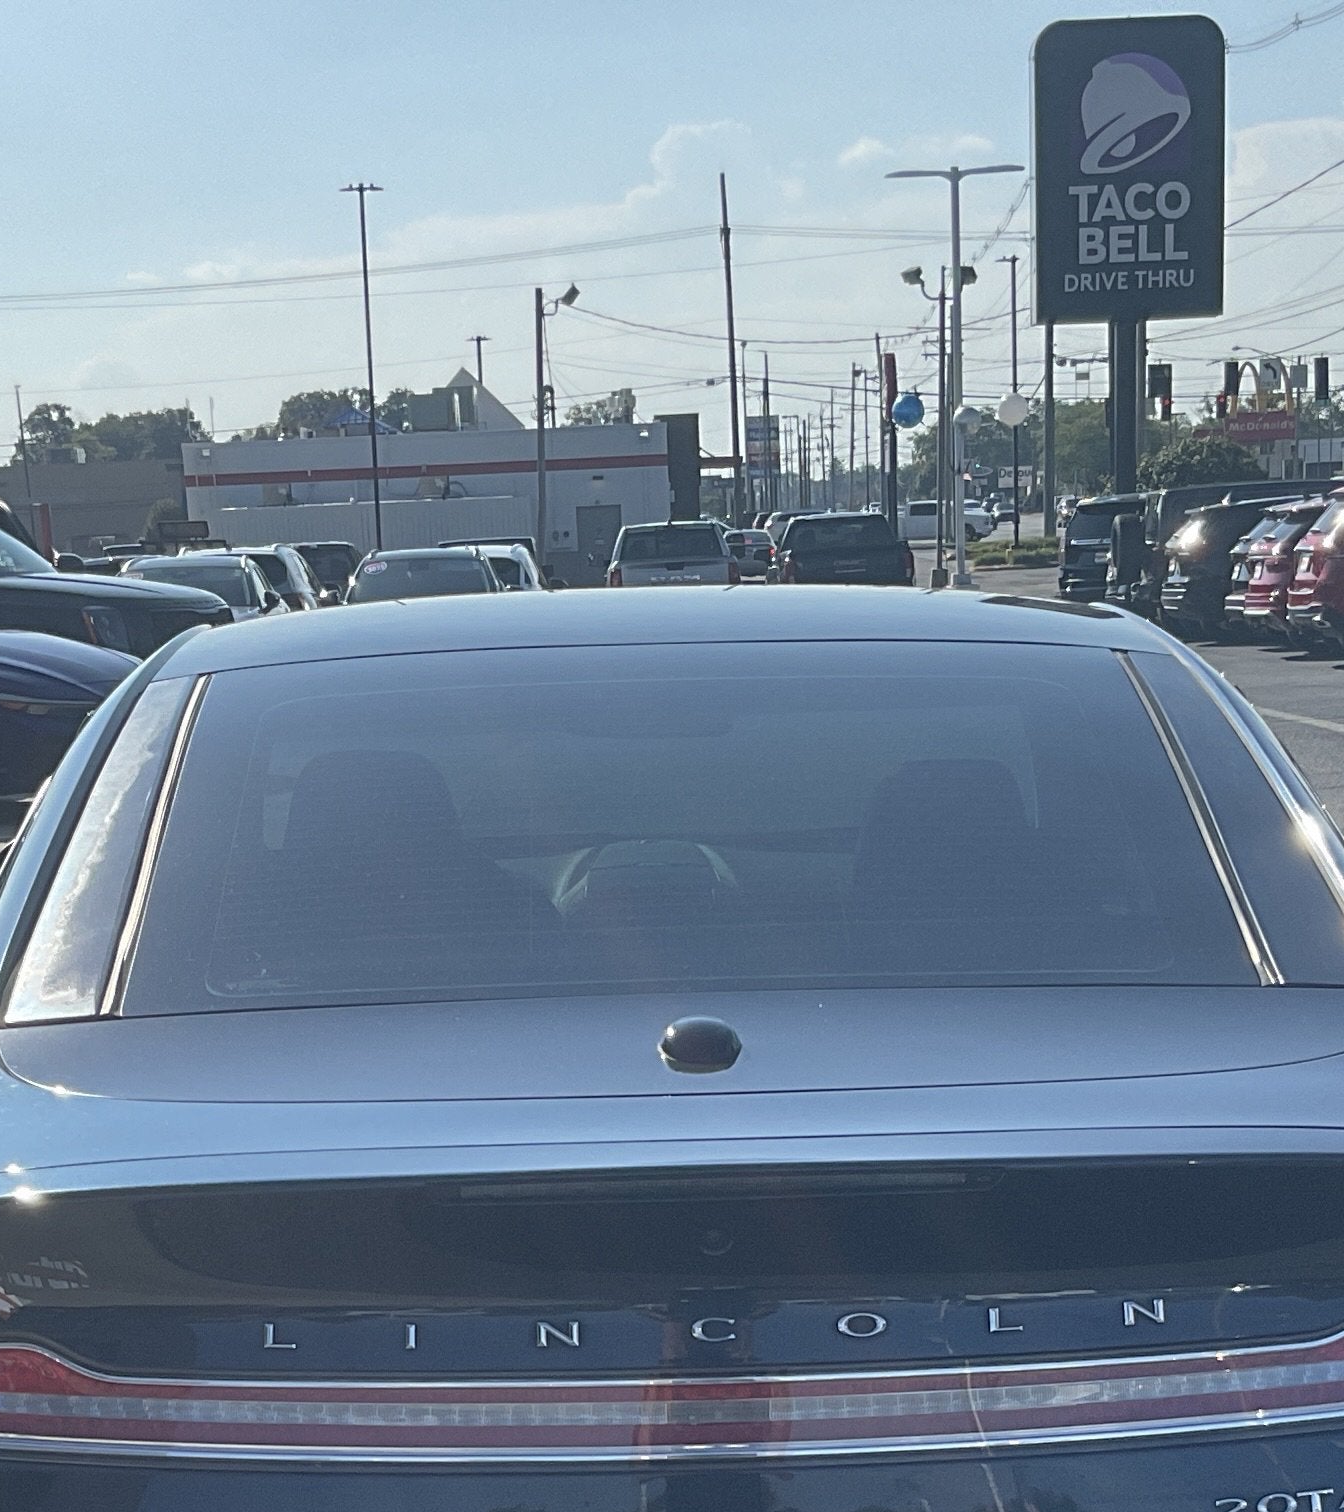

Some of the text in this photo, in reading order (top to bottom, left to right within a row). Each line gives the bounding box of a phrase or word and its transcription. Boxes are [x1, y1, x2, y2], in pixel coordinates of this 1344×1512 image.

[1068, 180, 1192, 223] TACO
[1077, 223, 1189, 266] BELL
[1064, 269, 1195, 293] DRIVE THRU
[264, 1297, 1167, 1350] LINCOLN
